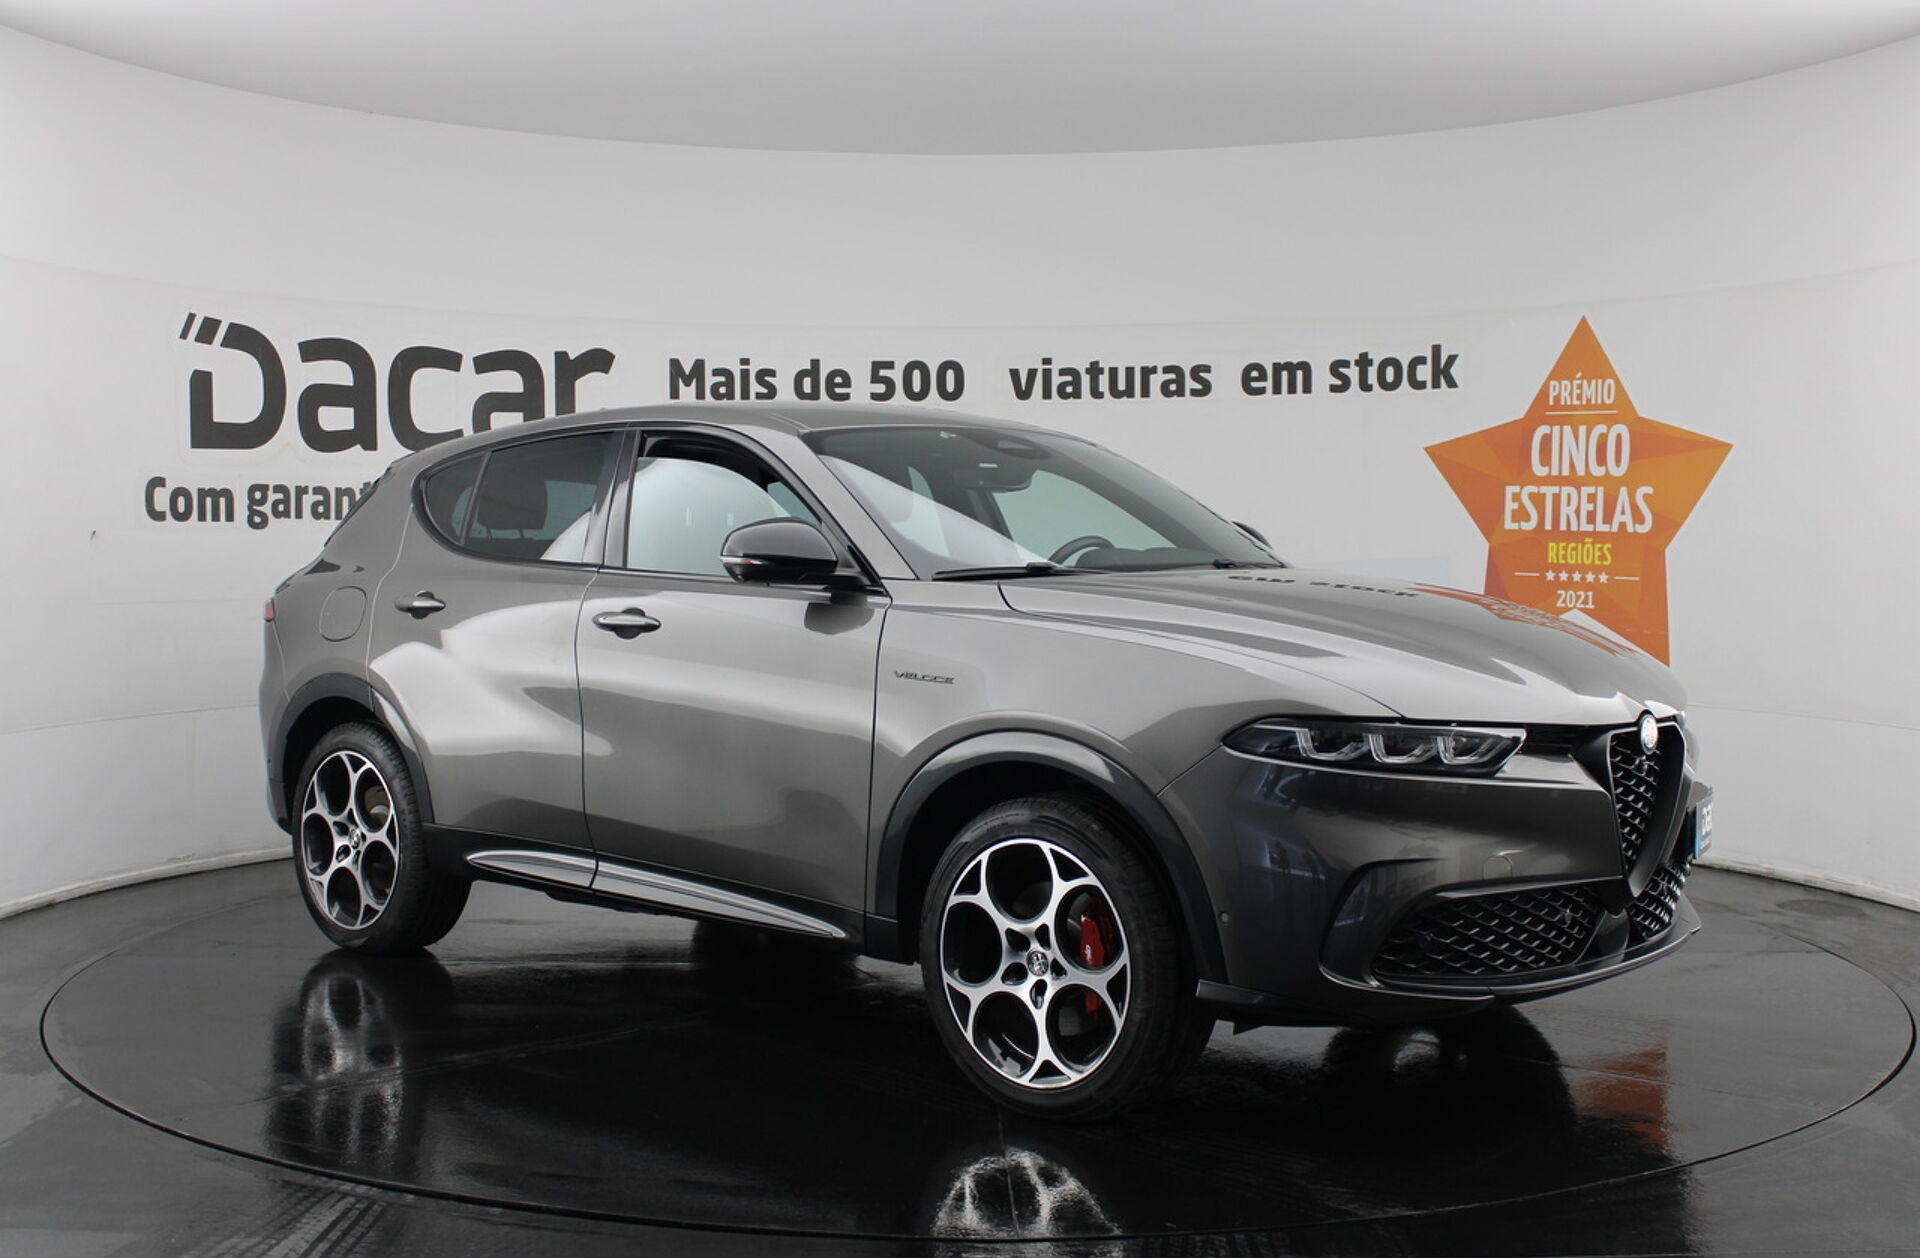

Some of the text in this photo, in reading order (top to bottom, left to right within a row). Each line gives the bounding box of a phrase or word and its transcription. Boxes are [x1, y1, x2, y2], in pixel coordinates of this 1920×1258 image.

[179, 312, 616, 453] Dacar
[668, 343, 1459, 402] Mais de 500 viaturas em stock
[1549, 372, 1616, 405] PRÉMIO
[1531, 423, 1631, 477] CINCO
[144, 476, 235, 523] Com
[1503, 485, 1654, 534] ESTRELAS
[1548, 538, 1612, 565] REGIÕES
[1556, 590, 1595, 609] 2021
[893, 670, 955, 685] VELOCE
